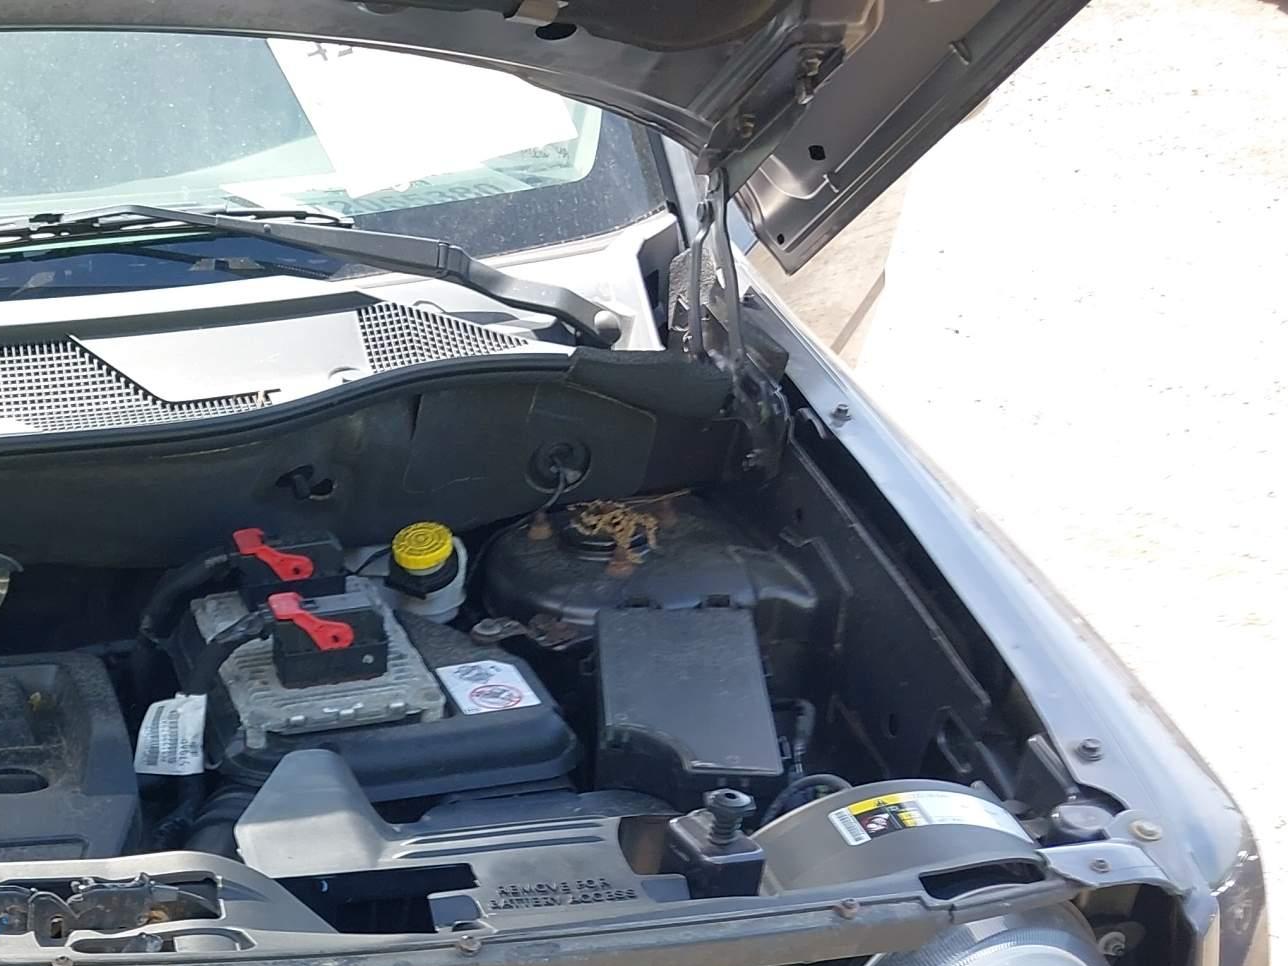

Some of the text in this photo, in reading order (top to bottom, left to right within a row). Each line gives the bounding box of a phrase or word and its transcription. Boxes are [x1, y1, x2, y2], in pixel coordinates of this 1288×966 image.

[497, 877, 612, 897] REMOVE FOR
[489, 888, 638, 911] BATTERY ACCESS
